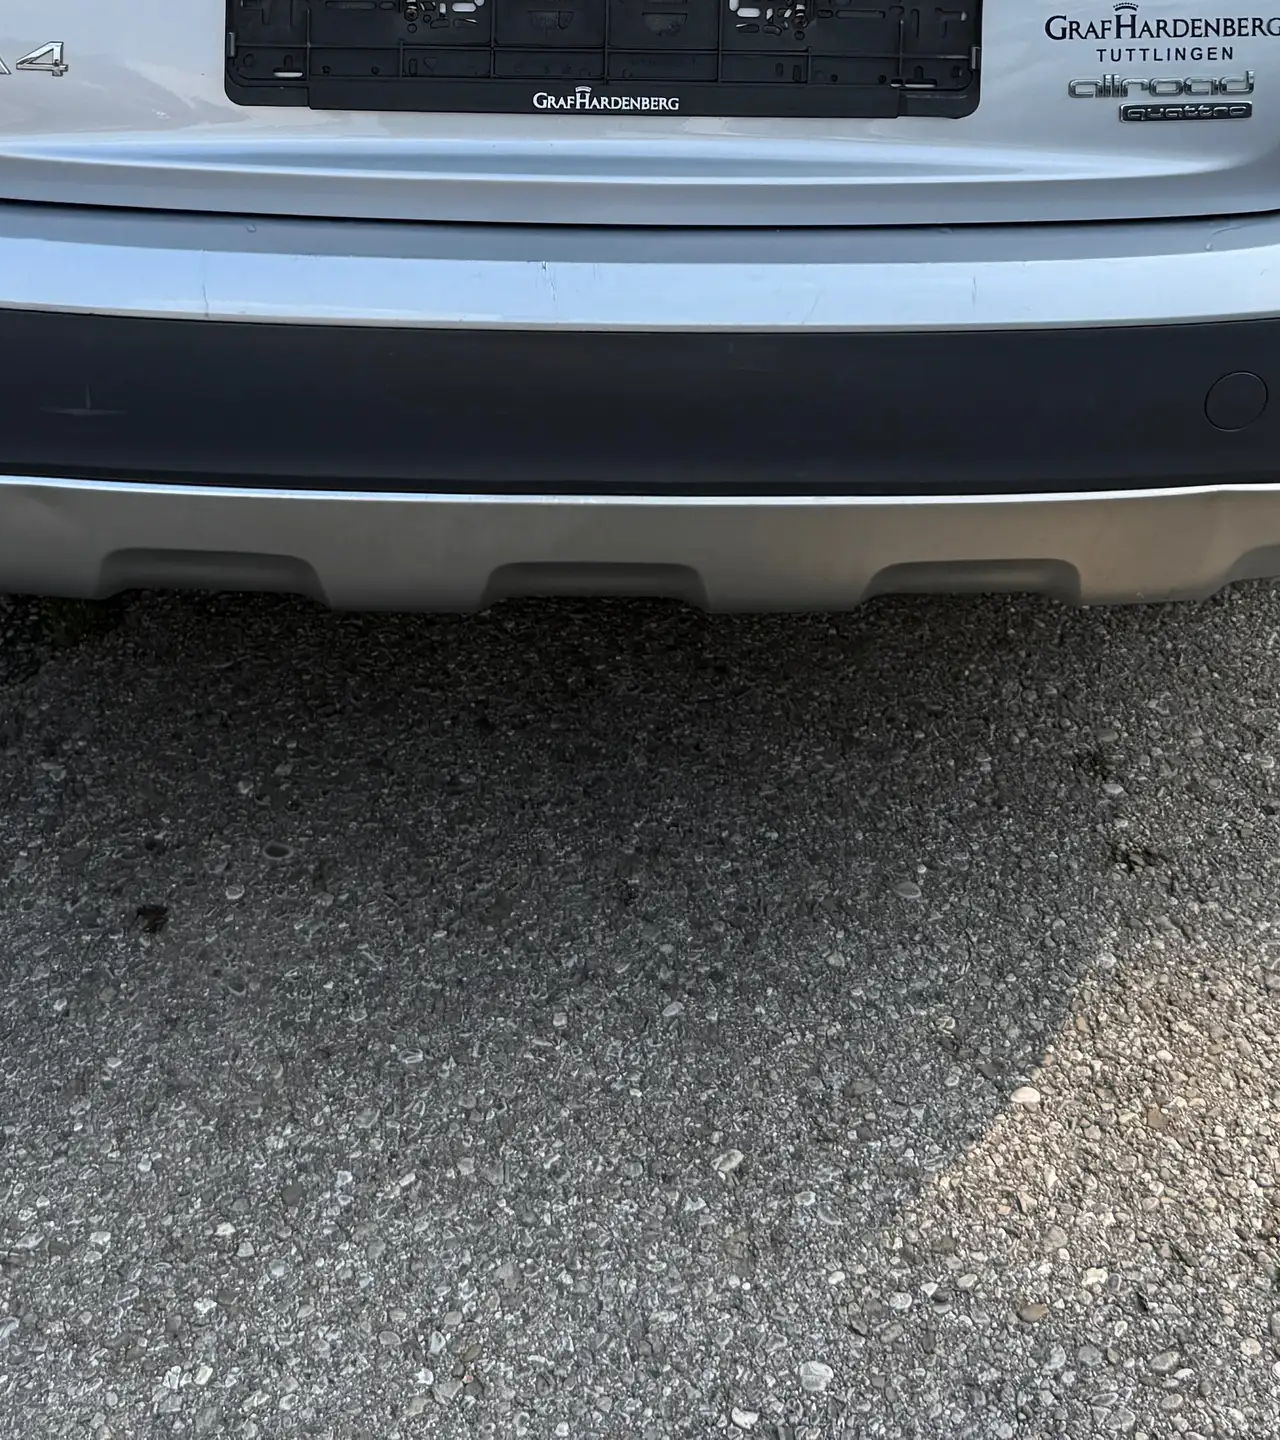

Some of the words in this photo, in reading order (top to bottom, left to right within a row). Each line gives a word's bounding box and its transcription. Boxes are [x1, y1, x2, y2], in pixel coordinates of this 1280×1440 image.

[1096, 46, 1234, 63] TUTTLINGEN
[1067, 69, 1255, 99] allroad
[1124, 103, 1249, 122] quattro
